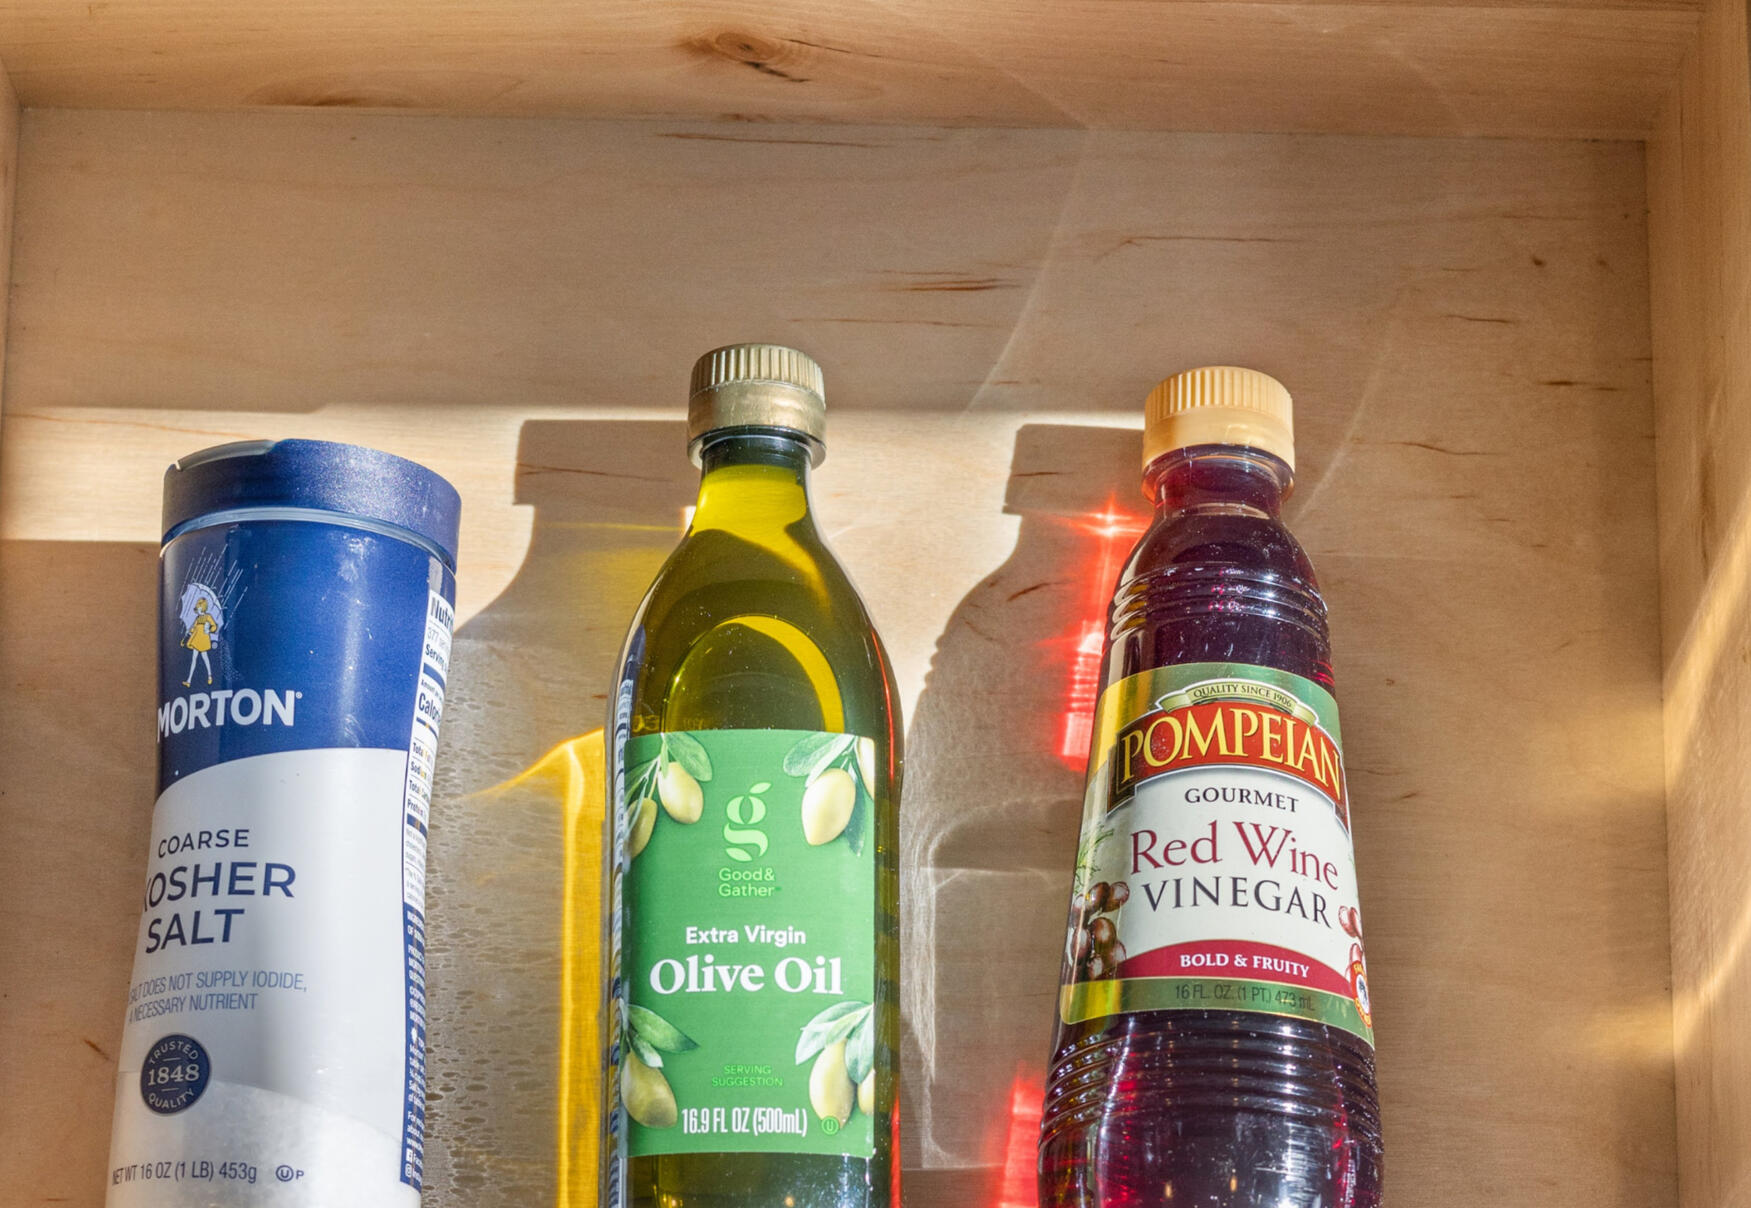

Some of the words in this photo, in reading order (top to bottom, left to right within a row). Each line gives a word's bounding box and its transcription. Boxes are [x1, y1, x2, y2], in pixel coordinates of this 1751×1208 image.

[1193, 684, 1238, 699] QUALITY
[1241, 685, 1270, 698] SINCE
[1273, 692, 1292, 708] 1906
[1120, 707, 1341, 801] POMPEIAN
[1185, 787, 1300, 813] GOURMET
[158, 829, 249, 858] COARSE
[1130, 820, 1222, 876] Red
[1233, 821, 1339, 890] Wine
[718, 883, 775, 898] Gather
[1142, 876, 1333, 929] VINEGAR
[145, 908, 245, 954] SALT
[686, 926, 738, 944] Extra
[744, 925, 806, 948] Virgin
[649, 954, 765, 994] Olive
[774, 955, 844, 996] Oil
[1180, 953, 1229, 968] BOLD
[1233, 954, 1248, 967] &
[1252, 955, 1309, 978] FRUITY
[143, 976, 167, 998] DOES
[169, 972, 193, 991] NOT
[196, 970, 249, 989] SUPPLY
[252, 971, 307, 992] IODIDE,
[1175, 985, 1189, 999] 16
[1274, 990, 1297, 1007] 473
[134, 995, 186, 1021] NECESSARY
[189, 993, 258, 1011] NUTRIENT
[150, 1040, 198, 1065] TRUSTED
[148, 1064, 200, 1086] 1848
[711, 1076, 783, 1087] SUGGESTION
[723, 1064, 772, 1074] SERVING
[148, 1088, 195, 1109] QUALITY
[681, 1107, 710, 1135] 16.9
[713, 1108, 727, 1132] FL
[732, 1108, 750, 1133] OZ
[753, 1107, 808, 1137] (500mL)
[125, 1164, 137, 1181] WT
[140, 1163, 152, 1179] 16
[156, 1161, 172, 1179] OZ
[175, 1161, 186, 1182] (1
[191, 1161, 214, 1182] LB)
[219, 1162, 257, 1184] 453g
